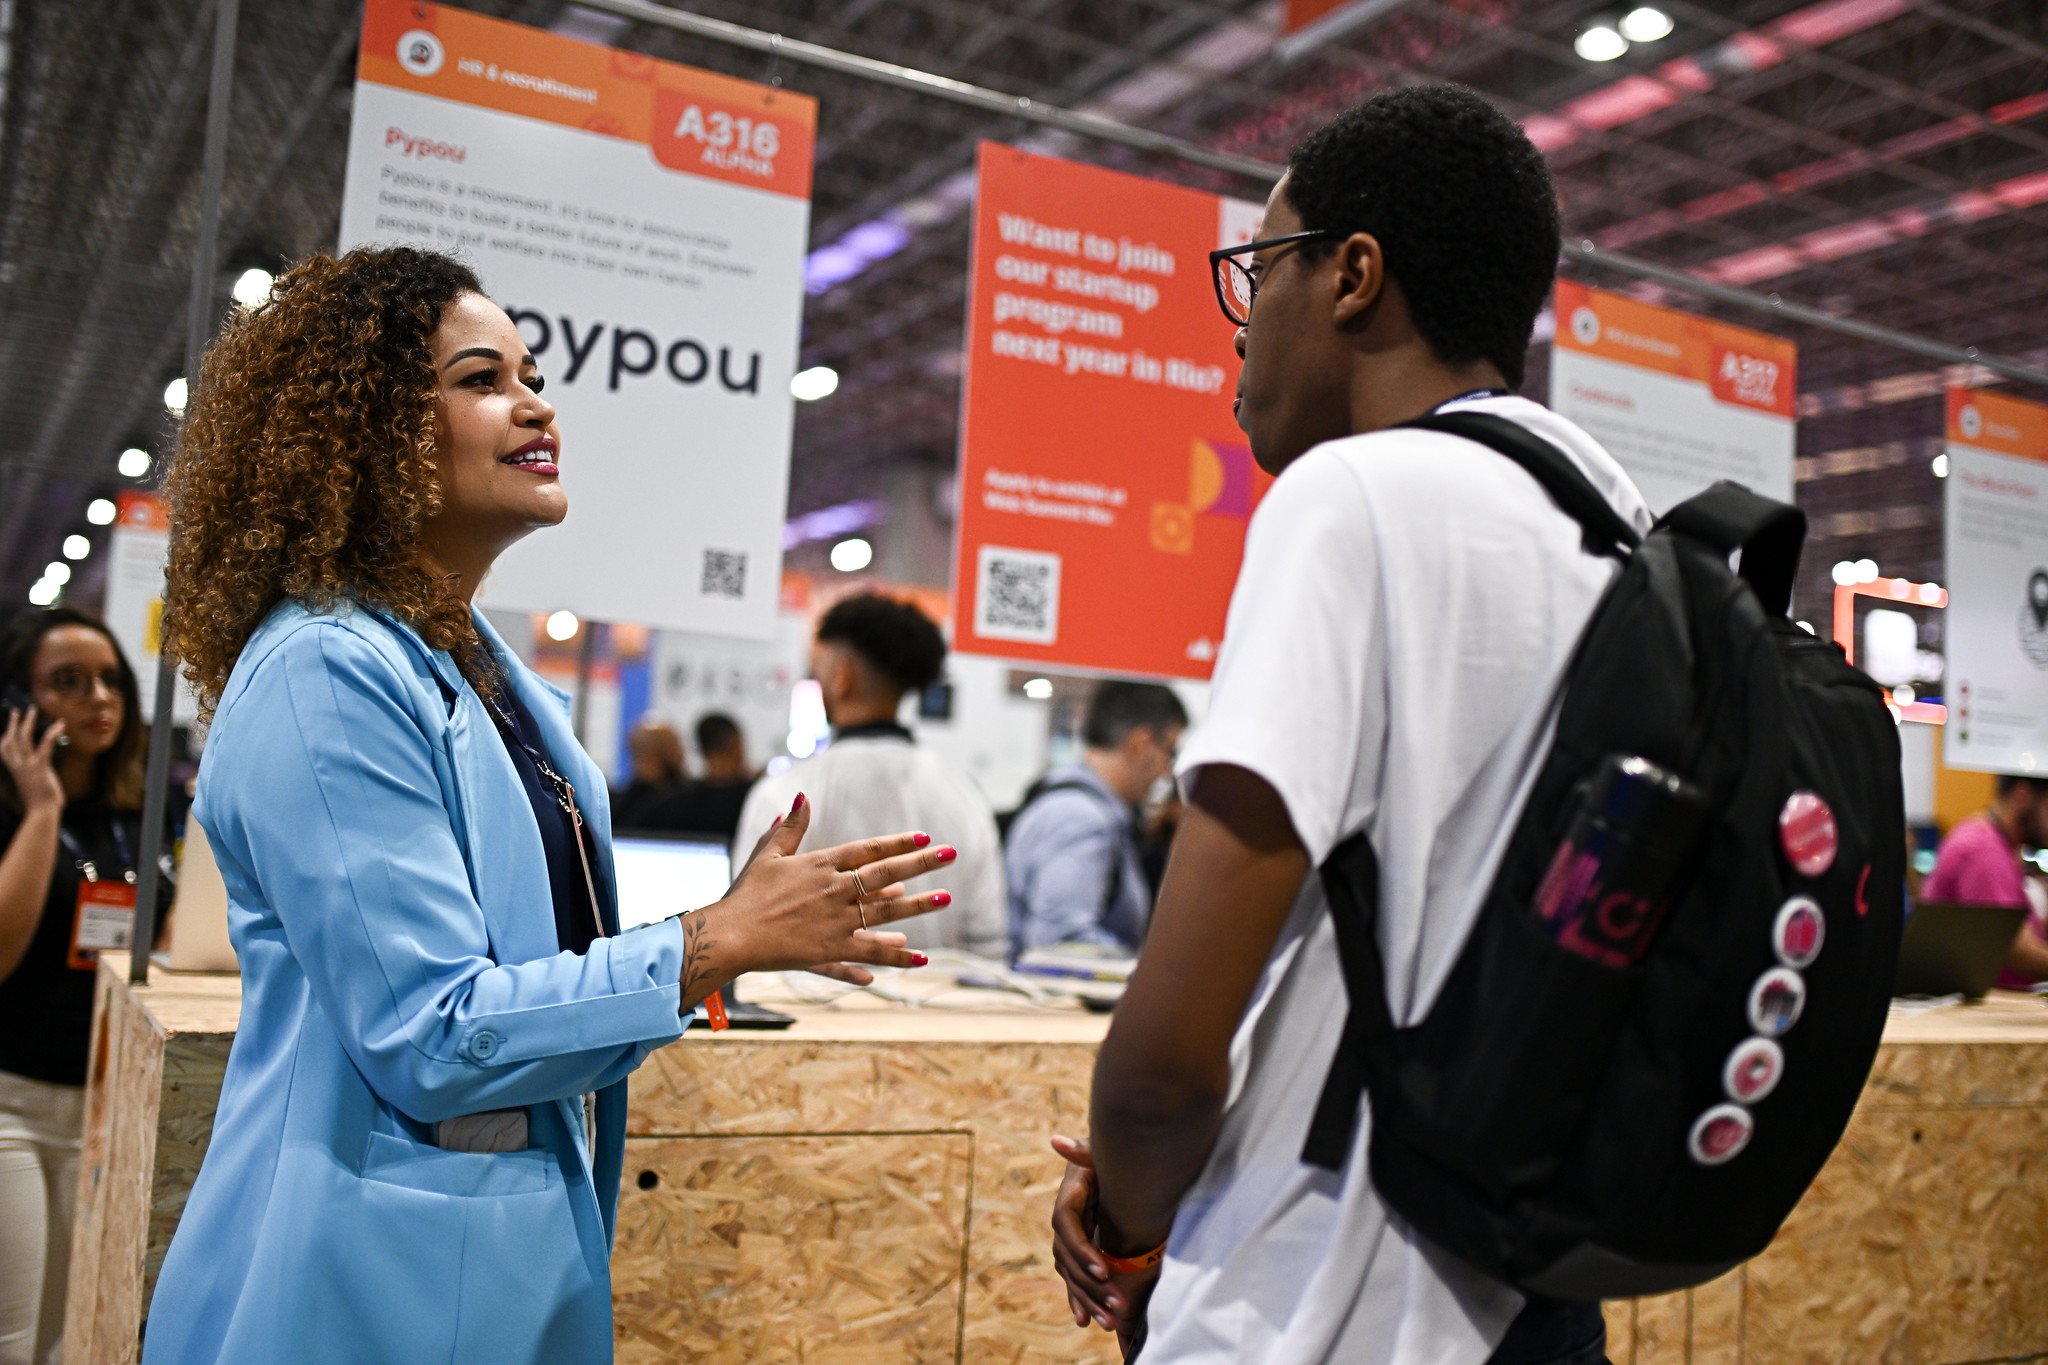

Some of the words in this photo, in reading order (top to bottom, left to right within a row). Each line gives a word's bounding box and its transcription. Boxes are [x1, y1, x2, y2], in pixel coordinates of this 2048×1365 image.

[458, 57, 484, 78] HR
[486, 62, 498, 81] &
[500, 67, 597, 104] recruitment
[385, 125, 467, 163] Pypou
[673, 105, 781, 158] A316
[701, 146, 774, 177] ALPHA
[997, 213, 1080, 255] Want
[1084, 234, 1116, 263] to
[1118, 237, 1175, 276] join
[995, 255, 1049, 285] our
[1052, 265, 1159, 314] startup
[993, 292, 1122, 339] program
[504, 303, 761, 395] pypou
[992, 330, 1060, 365] next
[1063, 342, 1128, 375] year
[1131, 350, 1161, 383] in
[1165, 356, 1225, 395] Rio?
